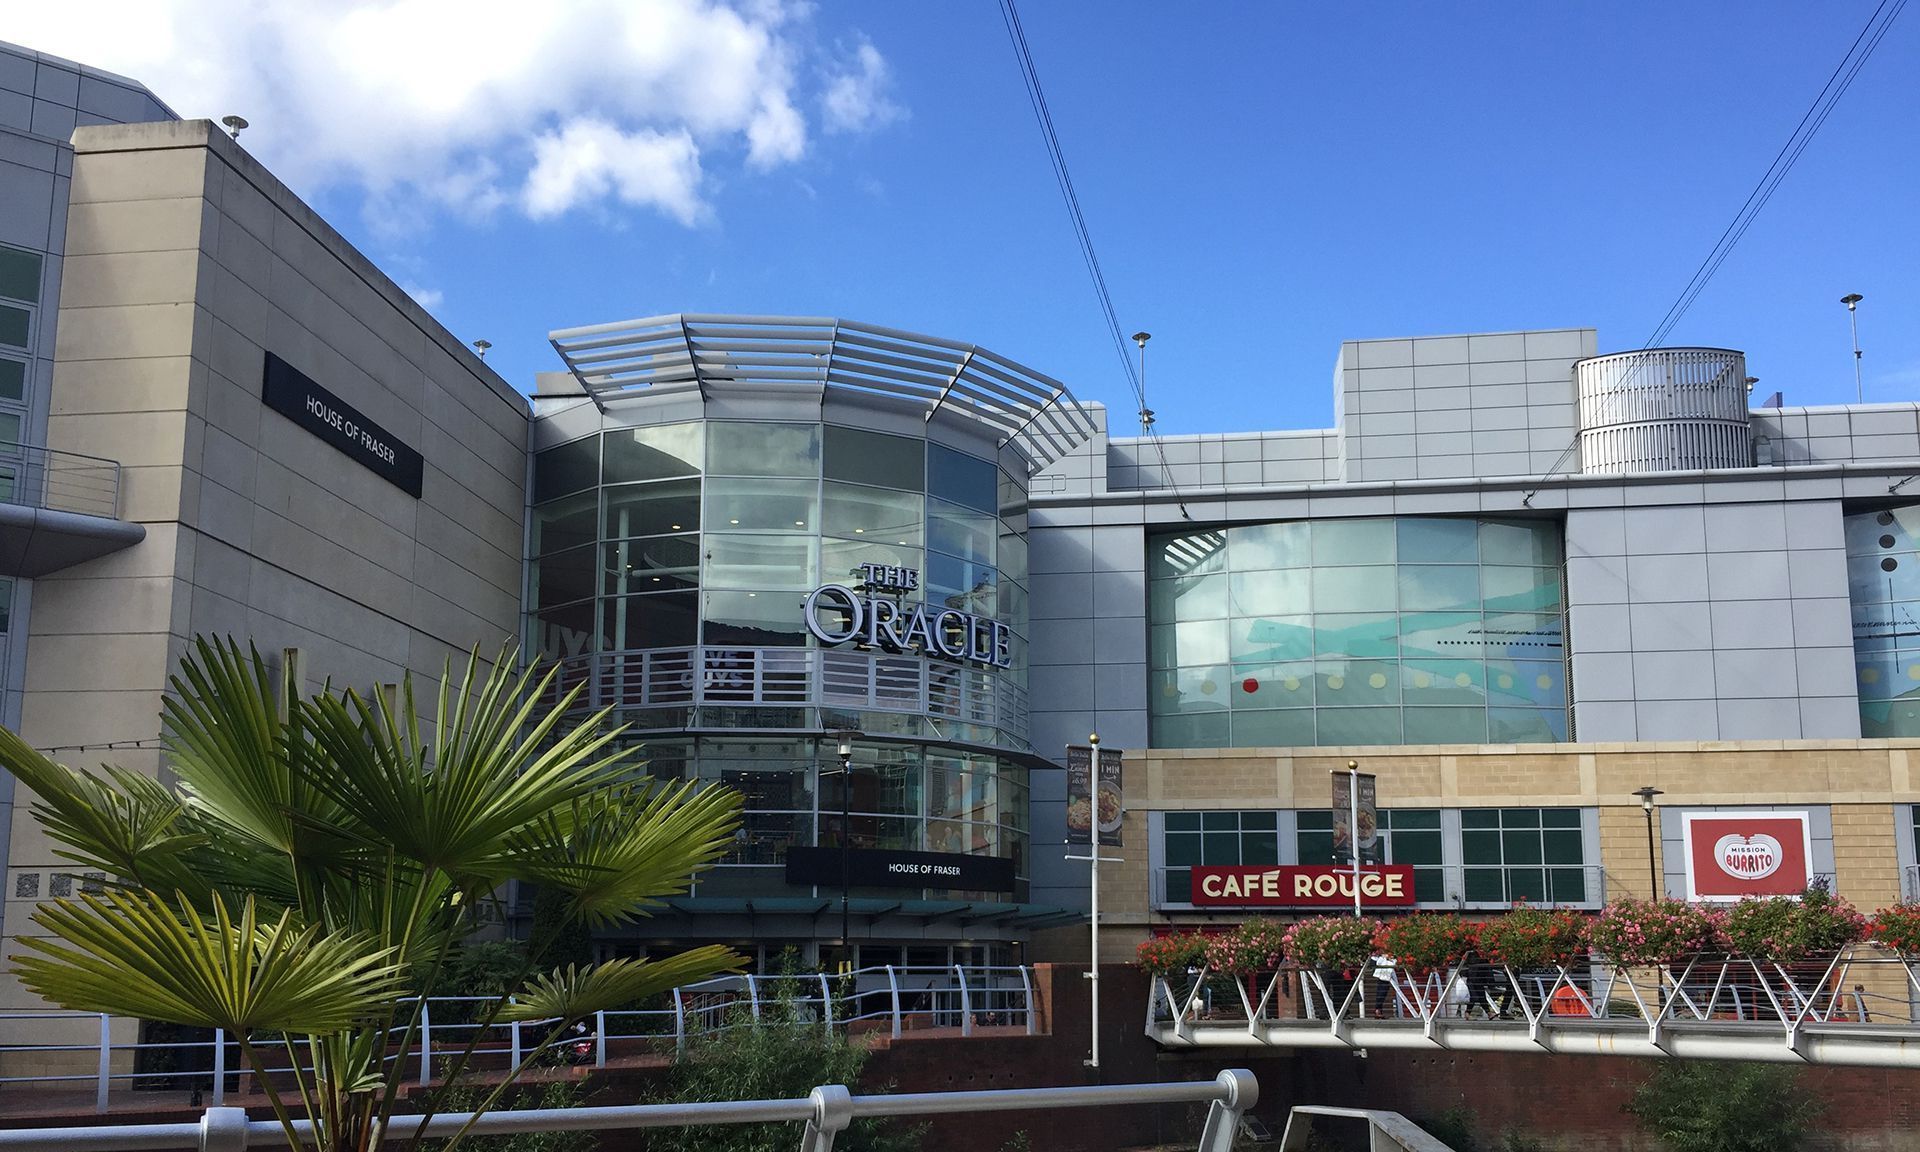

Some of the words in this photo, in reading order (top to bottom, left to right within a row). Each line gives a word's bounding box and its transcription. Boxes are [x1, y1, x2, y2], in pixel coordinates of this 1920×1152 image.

[305, 394, 343, 432] HOUSE
[344, 421, 360, 441] OF
[360, 430, 396, 466] FRASER
[859, 562, 919, 591] THE
[804, 583, 1012, 670] ORACLE
[1106, 765, 1120, 774] MIN
[888, 863, 919, 873] HOUSE
[920, 865, 932, 874] OF
[933, 865, 961, 875] FRASER
[1726, 854, 1772, 872] BURRITO
[1202, 869, 1281, 897] CAFÉ
[1294, 874, 1404, 897] ROUGE
